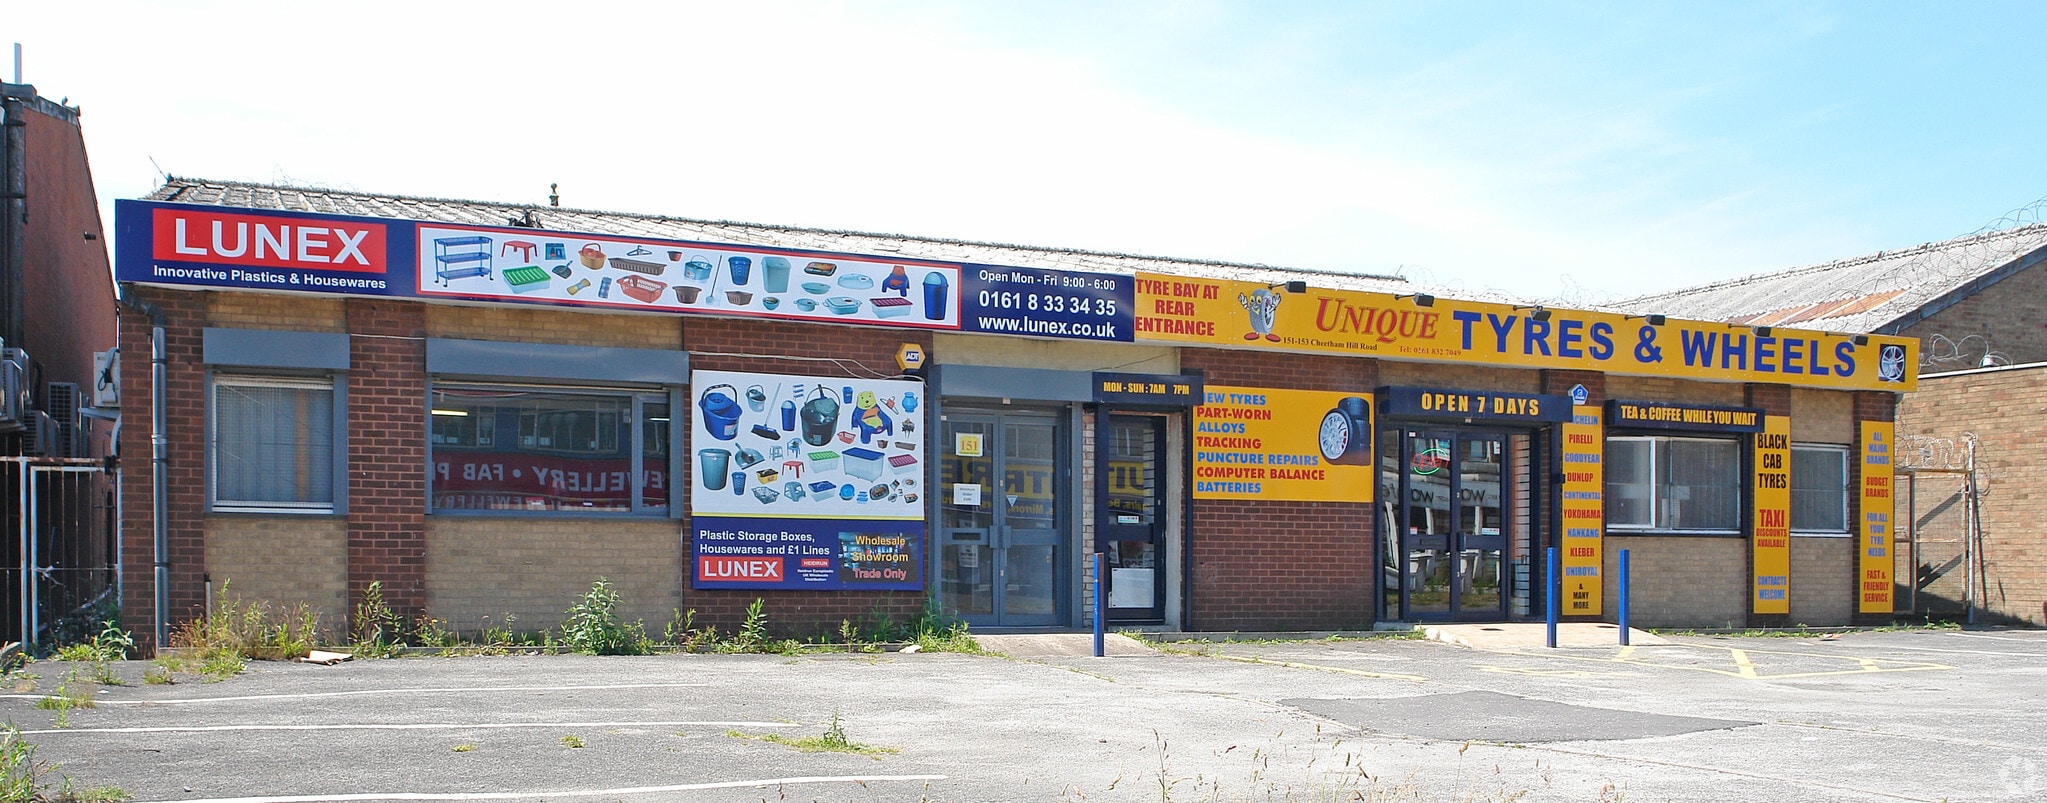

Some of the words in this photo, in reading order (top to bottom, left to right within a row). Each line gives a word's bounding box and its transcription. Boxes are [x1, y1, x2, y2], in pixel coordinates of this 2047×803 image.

[175, 218, 371, 266] LUNEX
[153, 265, 227, 281] Innovative
[231, 269, 286, 284] Plastics
[290, 273, 300, 285] &
[304, 274, 387, 289] Housewares
[979, 270, 1009, 285] Open
[1011, 272, 1034, 285] Mon
[1043, 274, 1058, 287] Fri
[1063, 277, 1085, 288] 9:00
[1094, 279, 1116, 291] 6:00
[1136, 279, 1171, 297] TYRE
[1173, 283, 1200, 299] BAY
[1202, 285, 1220, 300] AT
[979, 290, 1021, 309] 0161
[1028, 294, 1038, 311] 8
[1043, 296, 1065, 313] 33
[1069, 298, 1091, 315] 34
[1095, 300, 1116, 316] 35
[1155, 300, 1195, 317] REAR
[978, 314, 1116, 338] www.lunex.co.uk
[1135, 316, 1215, 337] ENTRANCE
[1283, 336, 1309, 346] 151-153
[1310, 339, 1345, 349] Cheetham
[1346, 341, 1359, 350] Hill
[1360, 342, 1378, 351] Road
[1453, 311, 1614, 360] TYRES
[1634, 325, 1663, 363] &
[1681, 330, 1856, 377] WHEELS
[906, 351, 919, 361] ADT
[1103, 381, 1122, 392] MON
[1173, 384, 1190, 395] 7PM
[1229, 394, 1266, 406] TYRES
[1421, 393, 1469, 412] OPEN
[1477, 396, 1486, 413] 7
[1494, 397, 1539, 416] DAYS
[1197, 406, 1271, 420] PART-WORN
[1621, 405, 1638, 420] TEA
[1639, 408, 1647, 420] &
[1649, 407, 1681, 422] COFFEE
[1683, 409, 1712, 424] WHILE
[1713, 410, 1731, 425] YOU
[1732, 411, 1757, 426] WAIT
[1197, 422, 1246, 434] ALLOYS
[960, 440, 977, 451] 151
[1196, 436, 1262, 449] TRACKING
[1568, 434, 1593, 444] PIRELLI
[1757, 433, 1788, 449] BLACK
[1197, 452, 1264, 464] PUNCTURE
[1268, 454, 1319, 466] REPAIRS
[1564, 452, 1600, 463] GOODYEAR
[1763, 453, 1782, 469] CAB
[1196, 466, 1265, 479] COMPUTER
[1270, 468, 1325, 481] BALANCE
[1567, 472, 1594, 483] DUNLOP
[1197, 481, 1262, 493] BATTERIES
[1758, 473, 1787, 489] TYRES
[1866, 476, 1888, 486] BUDGET
[1865, 488, 1889, 498] BRANDS
[1563, 509, 1601, 519] YOKOHAMA
[1759, 509, 1785, 527] TAXI
[699, 530, 735, 541] Plastic
[737, 530, 778, 544] Storage
[781, 531, 815, 543] Boxes,
[1756, 528, 1787, 537] DISCOUNTS
[855, 535, 906, 547] Wholesale
[1757, 538, 1785, 548] AVAILABLE
[699, 543, 764, 555] Housewares
[766, 544, 785, 555] and
[787, 545, 800, 555] £1
[803, 545, 830, 556] Lines
[1570, 547, 1595, 557] KLEBER
[851, 551, 909, 563] Showroom
[704, 560, 779, 578] LUNEX
[854, 568, 882, 579] Trade
[883, 568, 907, 581] Only
[1565, 566, 1598, 576] UNIROYAL
[1866, 570, 1881, 579] FAST
[1757, 576, 1787, 586] CONTRACTS
[1863, 581, 1889, 591] FRIENDLY
[1573, 592, 1589, 600] MANY
[1758, 589, 1785, 599] WELCOME
[1864, 593, 1888, 603] SERVICE
[1573, 601, 1589, 609] MORE
